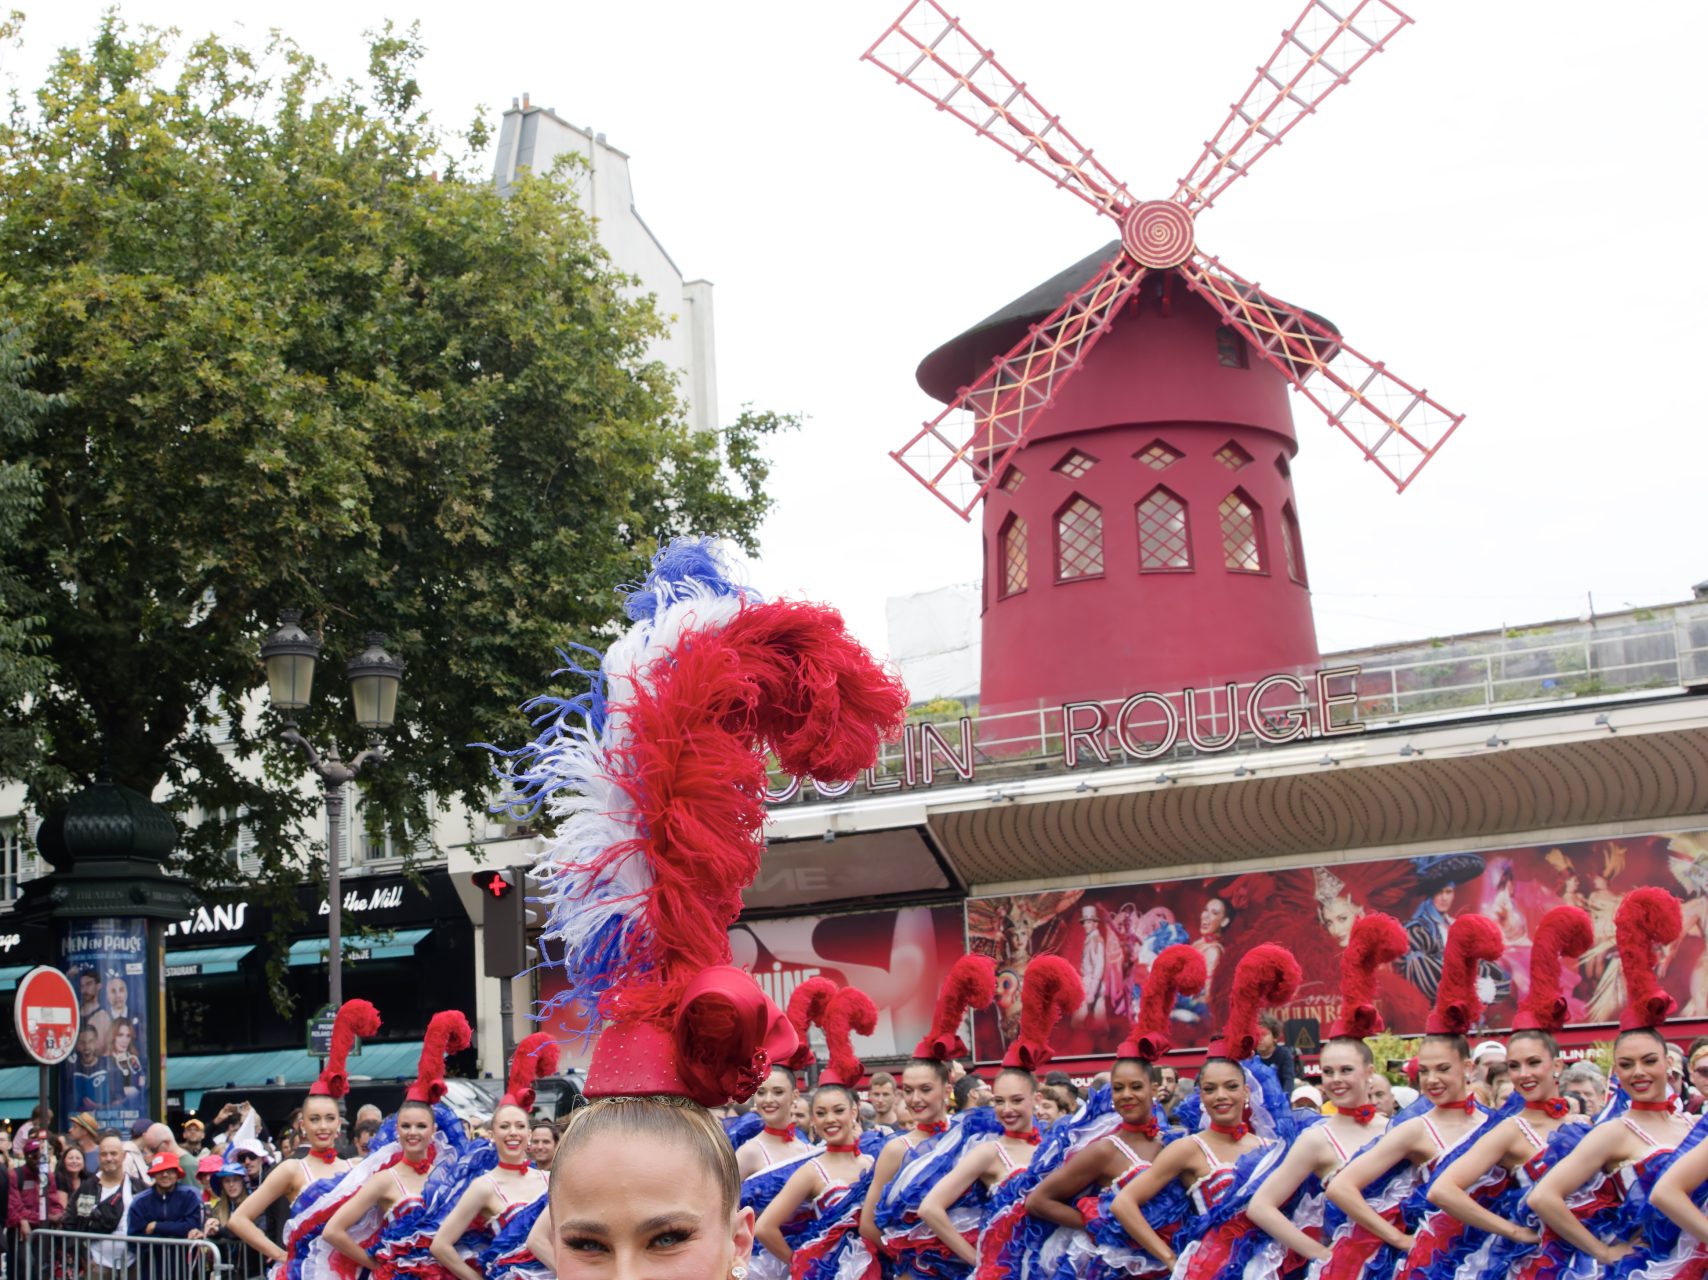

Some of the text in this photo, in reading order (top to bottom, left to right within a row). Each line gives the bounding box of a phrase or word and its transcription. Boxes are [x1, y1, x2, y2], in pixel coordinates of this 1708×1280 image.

[1061, 665, 1366, 767] ROUGE
[343, 890, 368, 912] the
[368, 886, 403, 910] Mill
[61, 935, 88, 956] MEN
[104, 935, 142, 954] PAUSE
